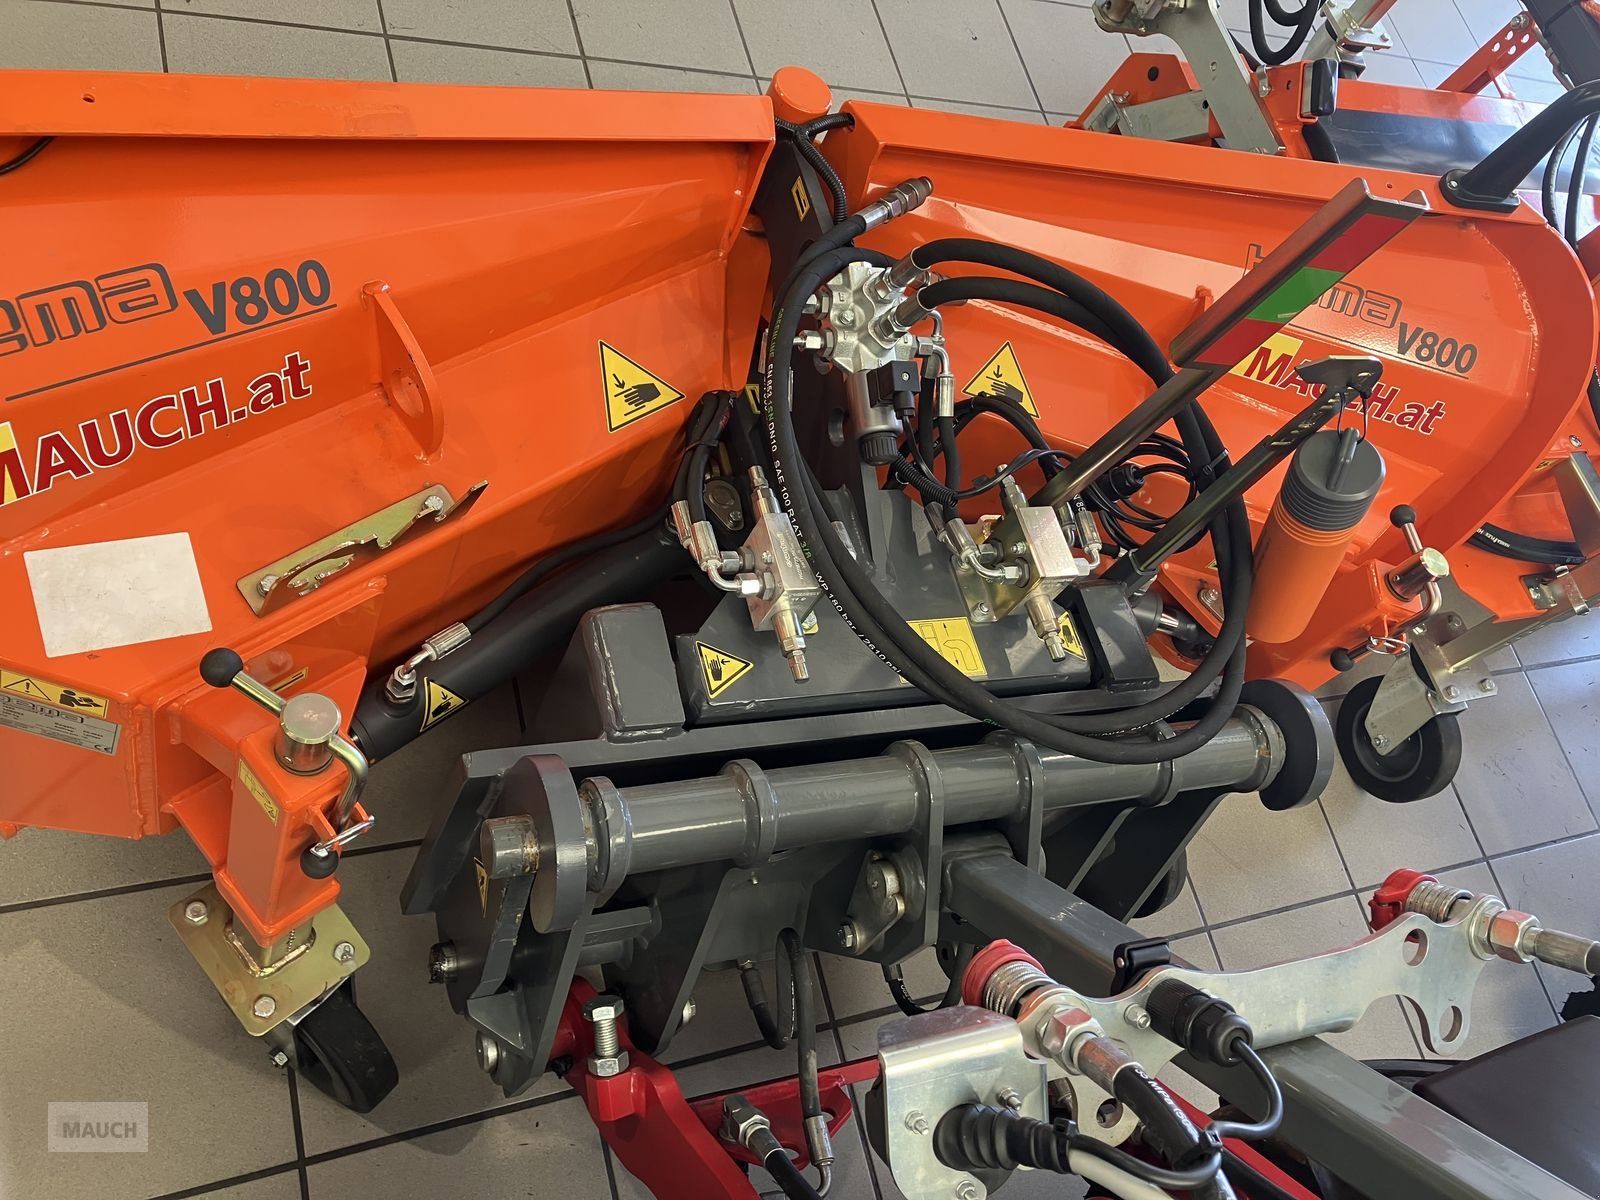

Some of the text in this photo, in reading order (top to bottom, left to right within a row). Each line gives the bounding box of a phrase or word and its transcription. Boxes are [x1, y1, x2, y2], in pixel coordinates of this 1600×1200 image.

[183, 259, 331, 335] V800
[1397, 322, 1478, 375] V800
[768, 422, 778, 452] DN10
[773, 460, 785, 483] SAE
[780, 487, 792, 508] 100
[787, 508, 803, 538] R1AT
[815, 571, 829, 592] WP
[828, 593, 843, 612] 180
[841, 612, 857, 631] bar
[1148, 1081, 1174, 1105] MPa
